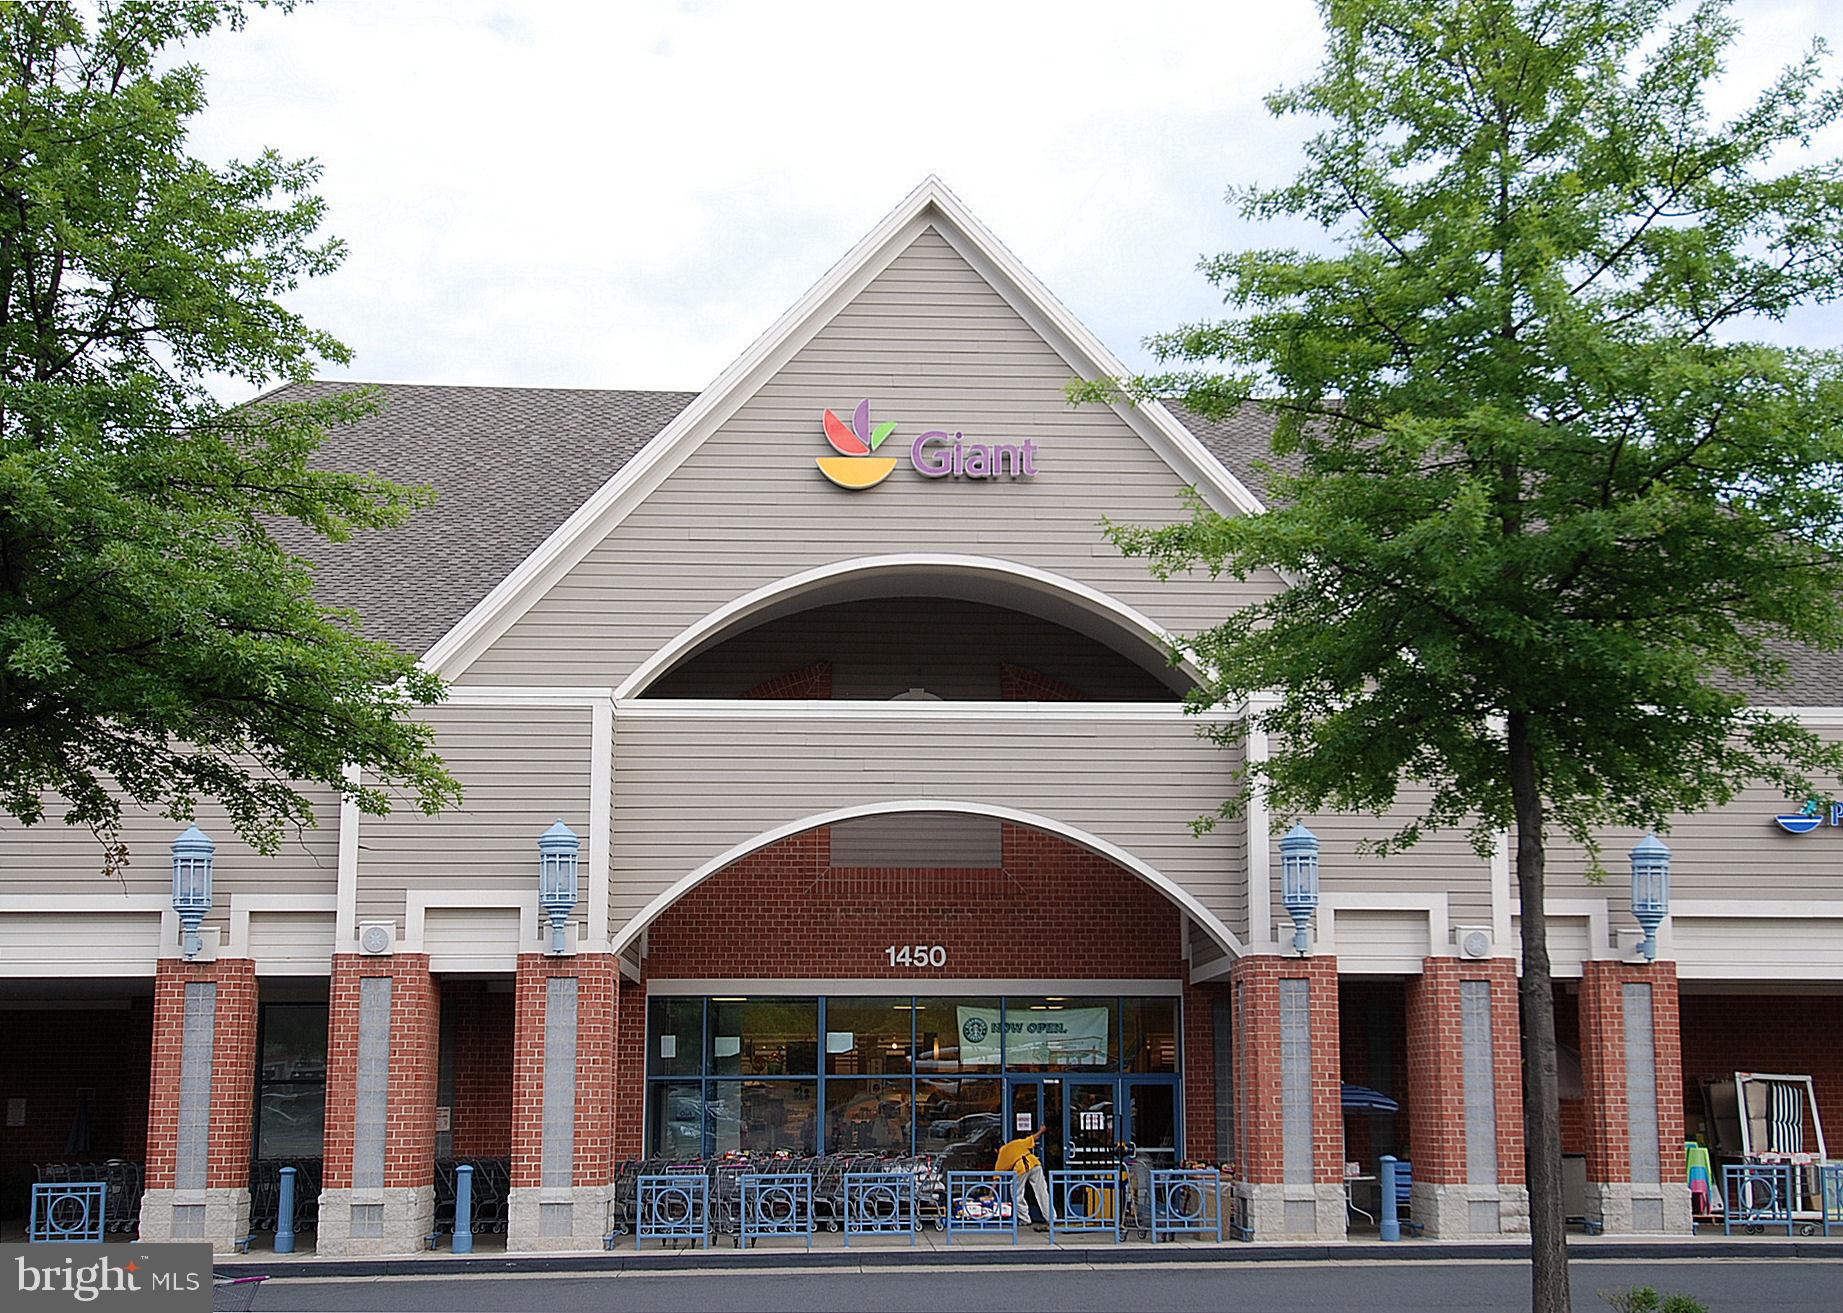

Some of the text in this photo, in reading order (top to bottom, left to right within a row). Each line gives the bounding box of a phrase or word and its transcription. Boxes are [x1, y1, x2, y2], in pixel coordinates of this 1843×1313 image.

[910, 430, 1040, 479] Giant
[885, 945, 947, 967] 1450
[991, 1022, 1023, 1034] NOW
